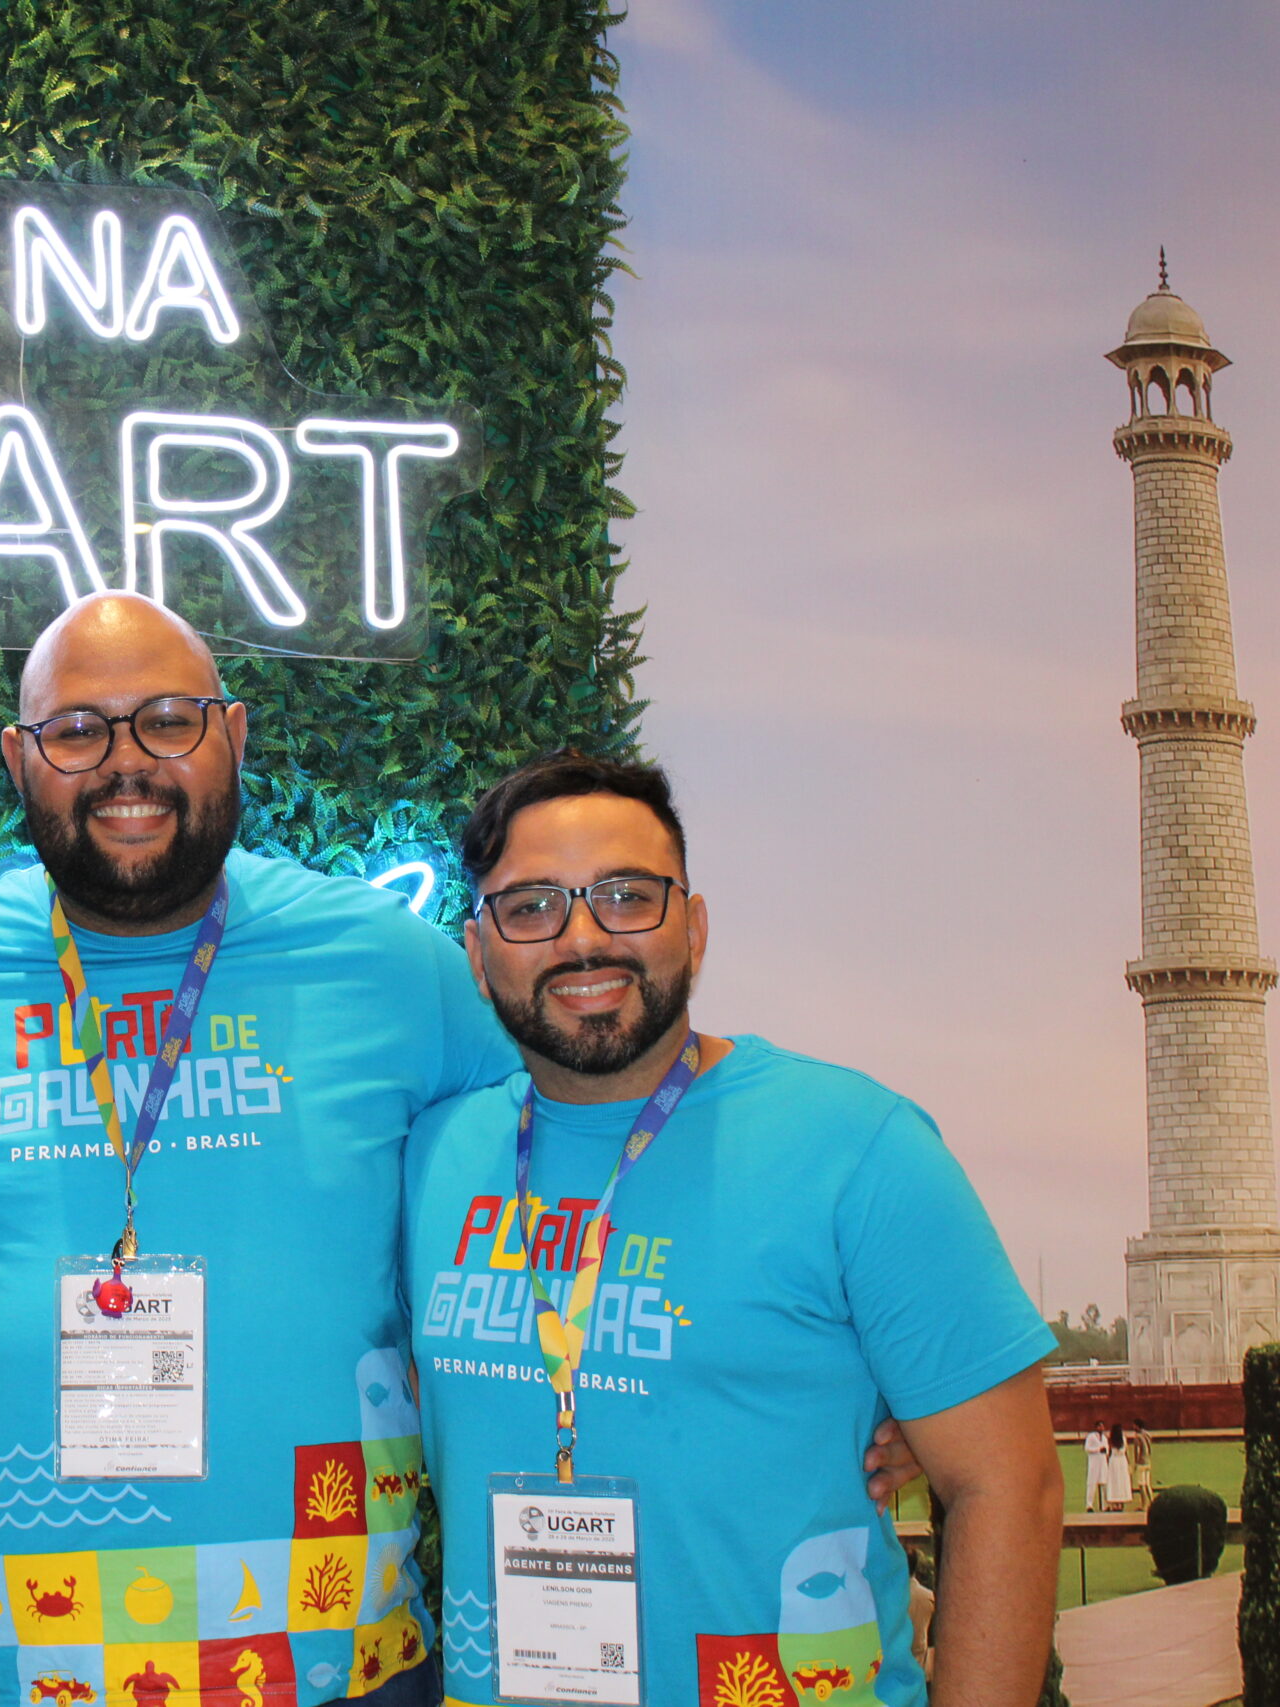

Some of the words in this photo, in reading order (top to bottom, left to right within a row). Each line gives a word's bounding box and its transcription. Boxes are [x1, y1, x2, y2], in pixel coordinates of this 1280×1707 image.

[13, 205, 240, 345] NA
[209, 1014, 259, 1052] DE
[11, 1139, 162, 1162] PERNAMBUO
[186, 1132, 261, 1151] BRASIL
[619, 1234, 672, 1280] DE
[124, 1299, 173, 1314] ART
[433, 1357, 552, 1384] PERNAMBUC
[579, 1373, 650, 1396] BRASIL
[547, 1515, 616, 1534] UGART
[504, 1557, 551, 1571] AGENTE
[556, 1560, 573, 1572] DE
[577, 1562, 633, 1575] VIAGENS
